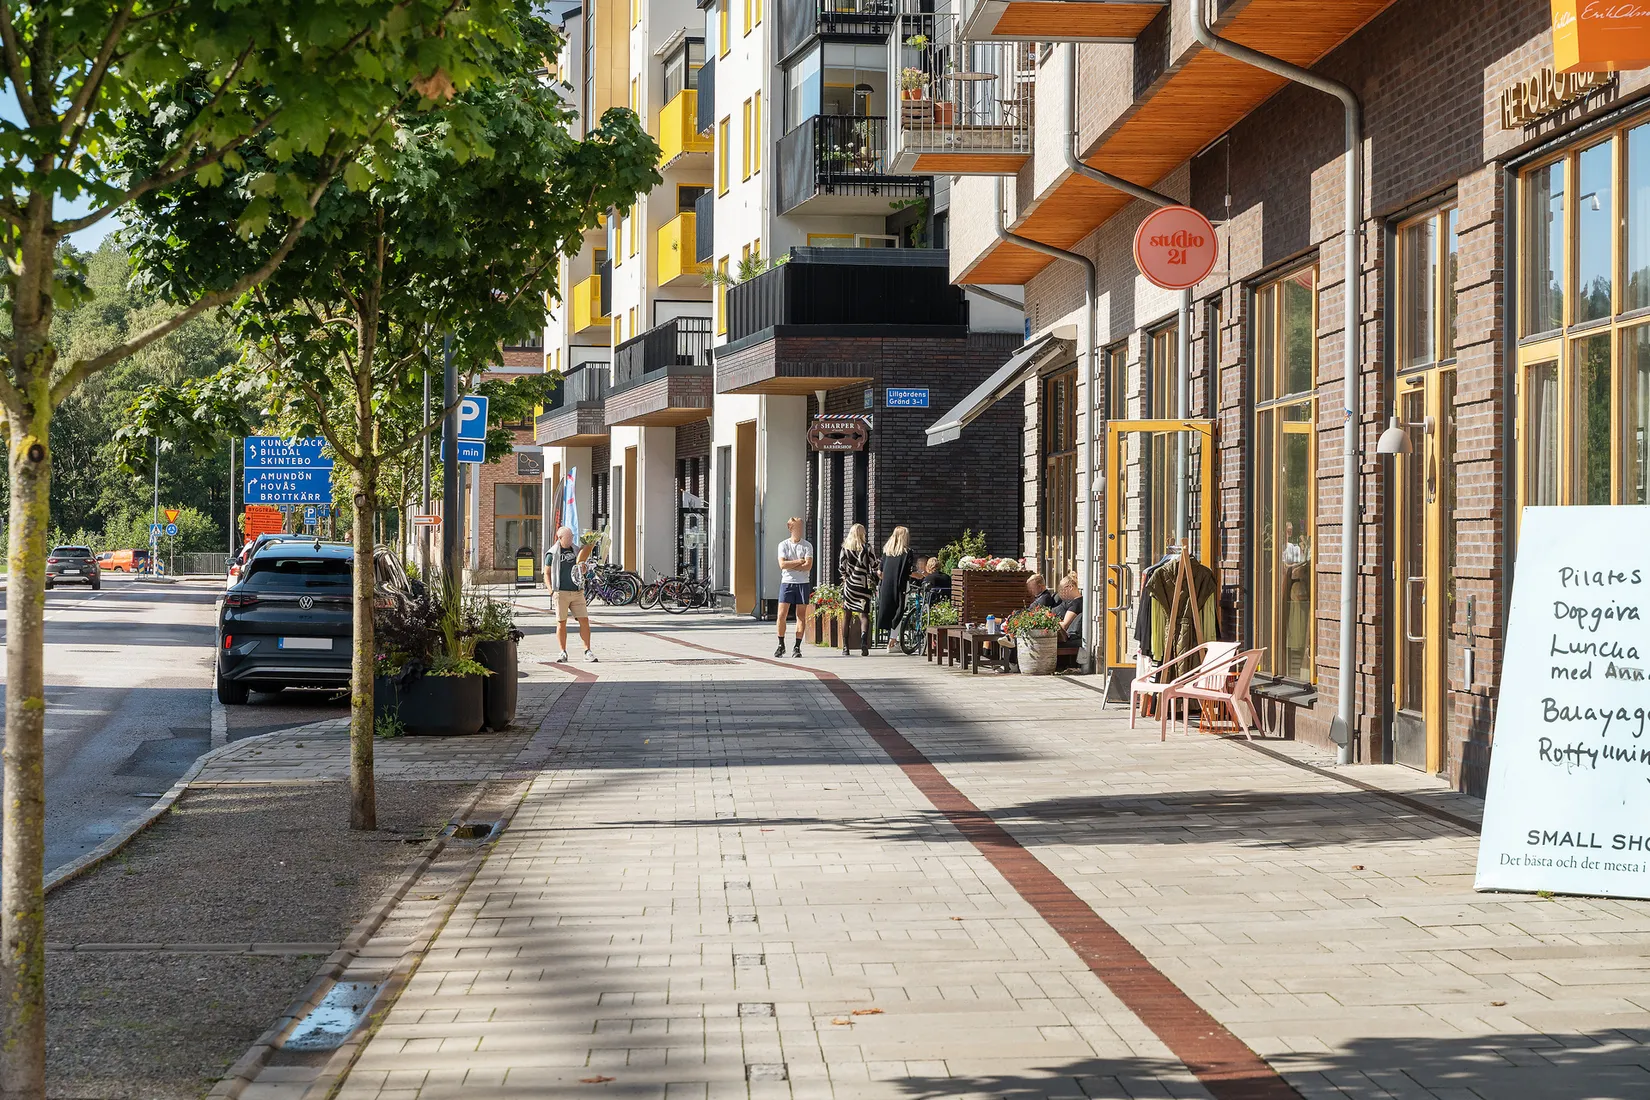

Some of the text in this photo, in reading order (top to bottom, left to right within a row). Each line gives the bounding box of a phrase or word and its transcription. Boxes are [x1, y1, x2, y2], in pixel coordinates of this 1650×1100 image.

[1521, 63, 1566, 119] POLPO
[1149, 229, 1204, 248] studio
[1167, 248, 1187, 265] 21
[889, 391, 926, 399] Lillgårdens
[457, 400, 480, 433] P
[260, 439, 331, 447] KUNGACKA
[260, 448, 301, 456] BILLDAL
[462, 448, 479, 456] min
[260, 457, 311, 465] SKINTEBO
[260, 471, 312, 480] AMUNDÖN
[260, 481, 296, 490] HOVÅS
[260, 491, 321, 500] BROTTKÄRR
[1558, 566, 1642, 588] Pilates
[1550, 633, 1640, 660] Luncha
[1551, 661, 1650, 681] med Ann
[1541, 697, 1650, 739] Balayag
[1538, 736, 1650, 770] Rotfyllnin
[1527, 829, 1602, 848] SMALL
[1500, 853, 1521, 866] Det
[1524, 854, 1552, 867] bästa
[1556, 856, 1577, 868] och
[1581, 857, 1600, 870] det
[1604, 862, 1639, 872] mesta
